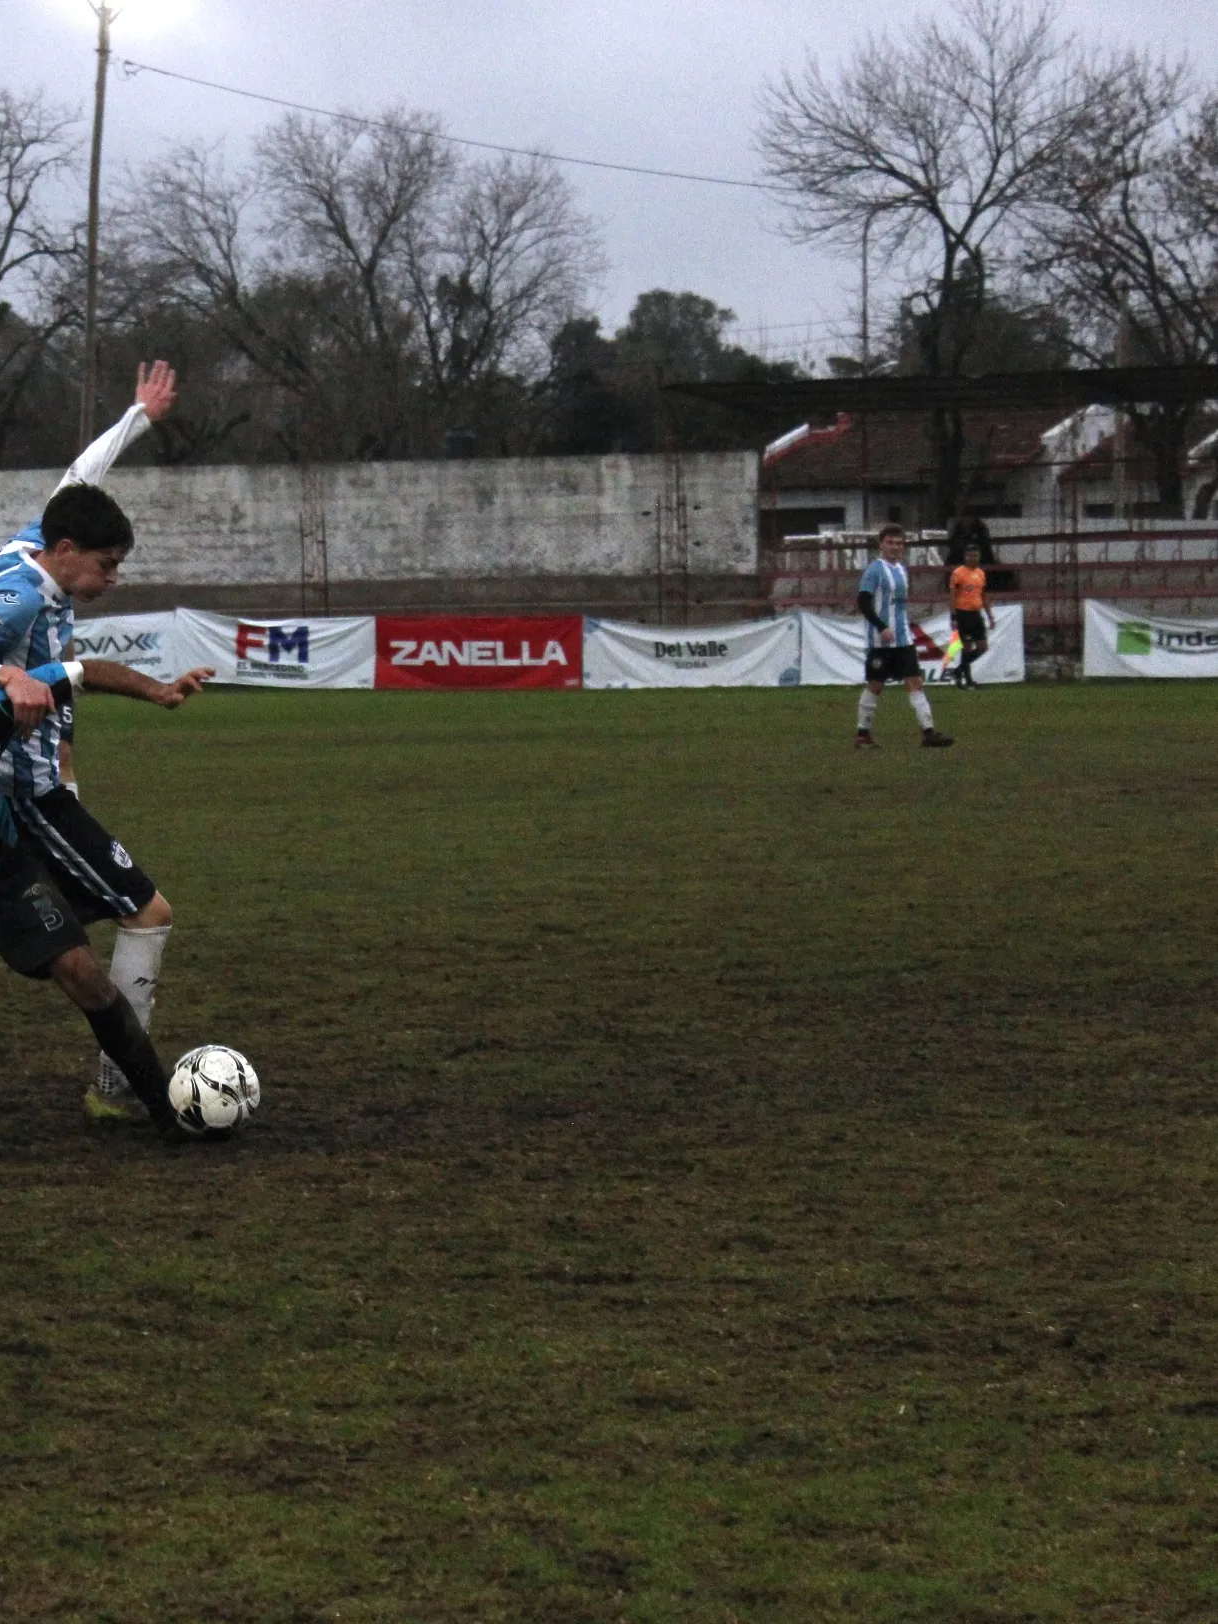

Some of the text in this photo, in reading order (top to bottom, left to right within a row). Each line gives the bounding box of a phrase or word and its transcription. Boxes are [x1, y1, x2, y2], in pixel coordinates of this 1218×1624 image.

[236, 624, 309, 663] FM
[389, 640, 568, 666] ZANELLA
[654, 640, 728, 658] Del Valle
